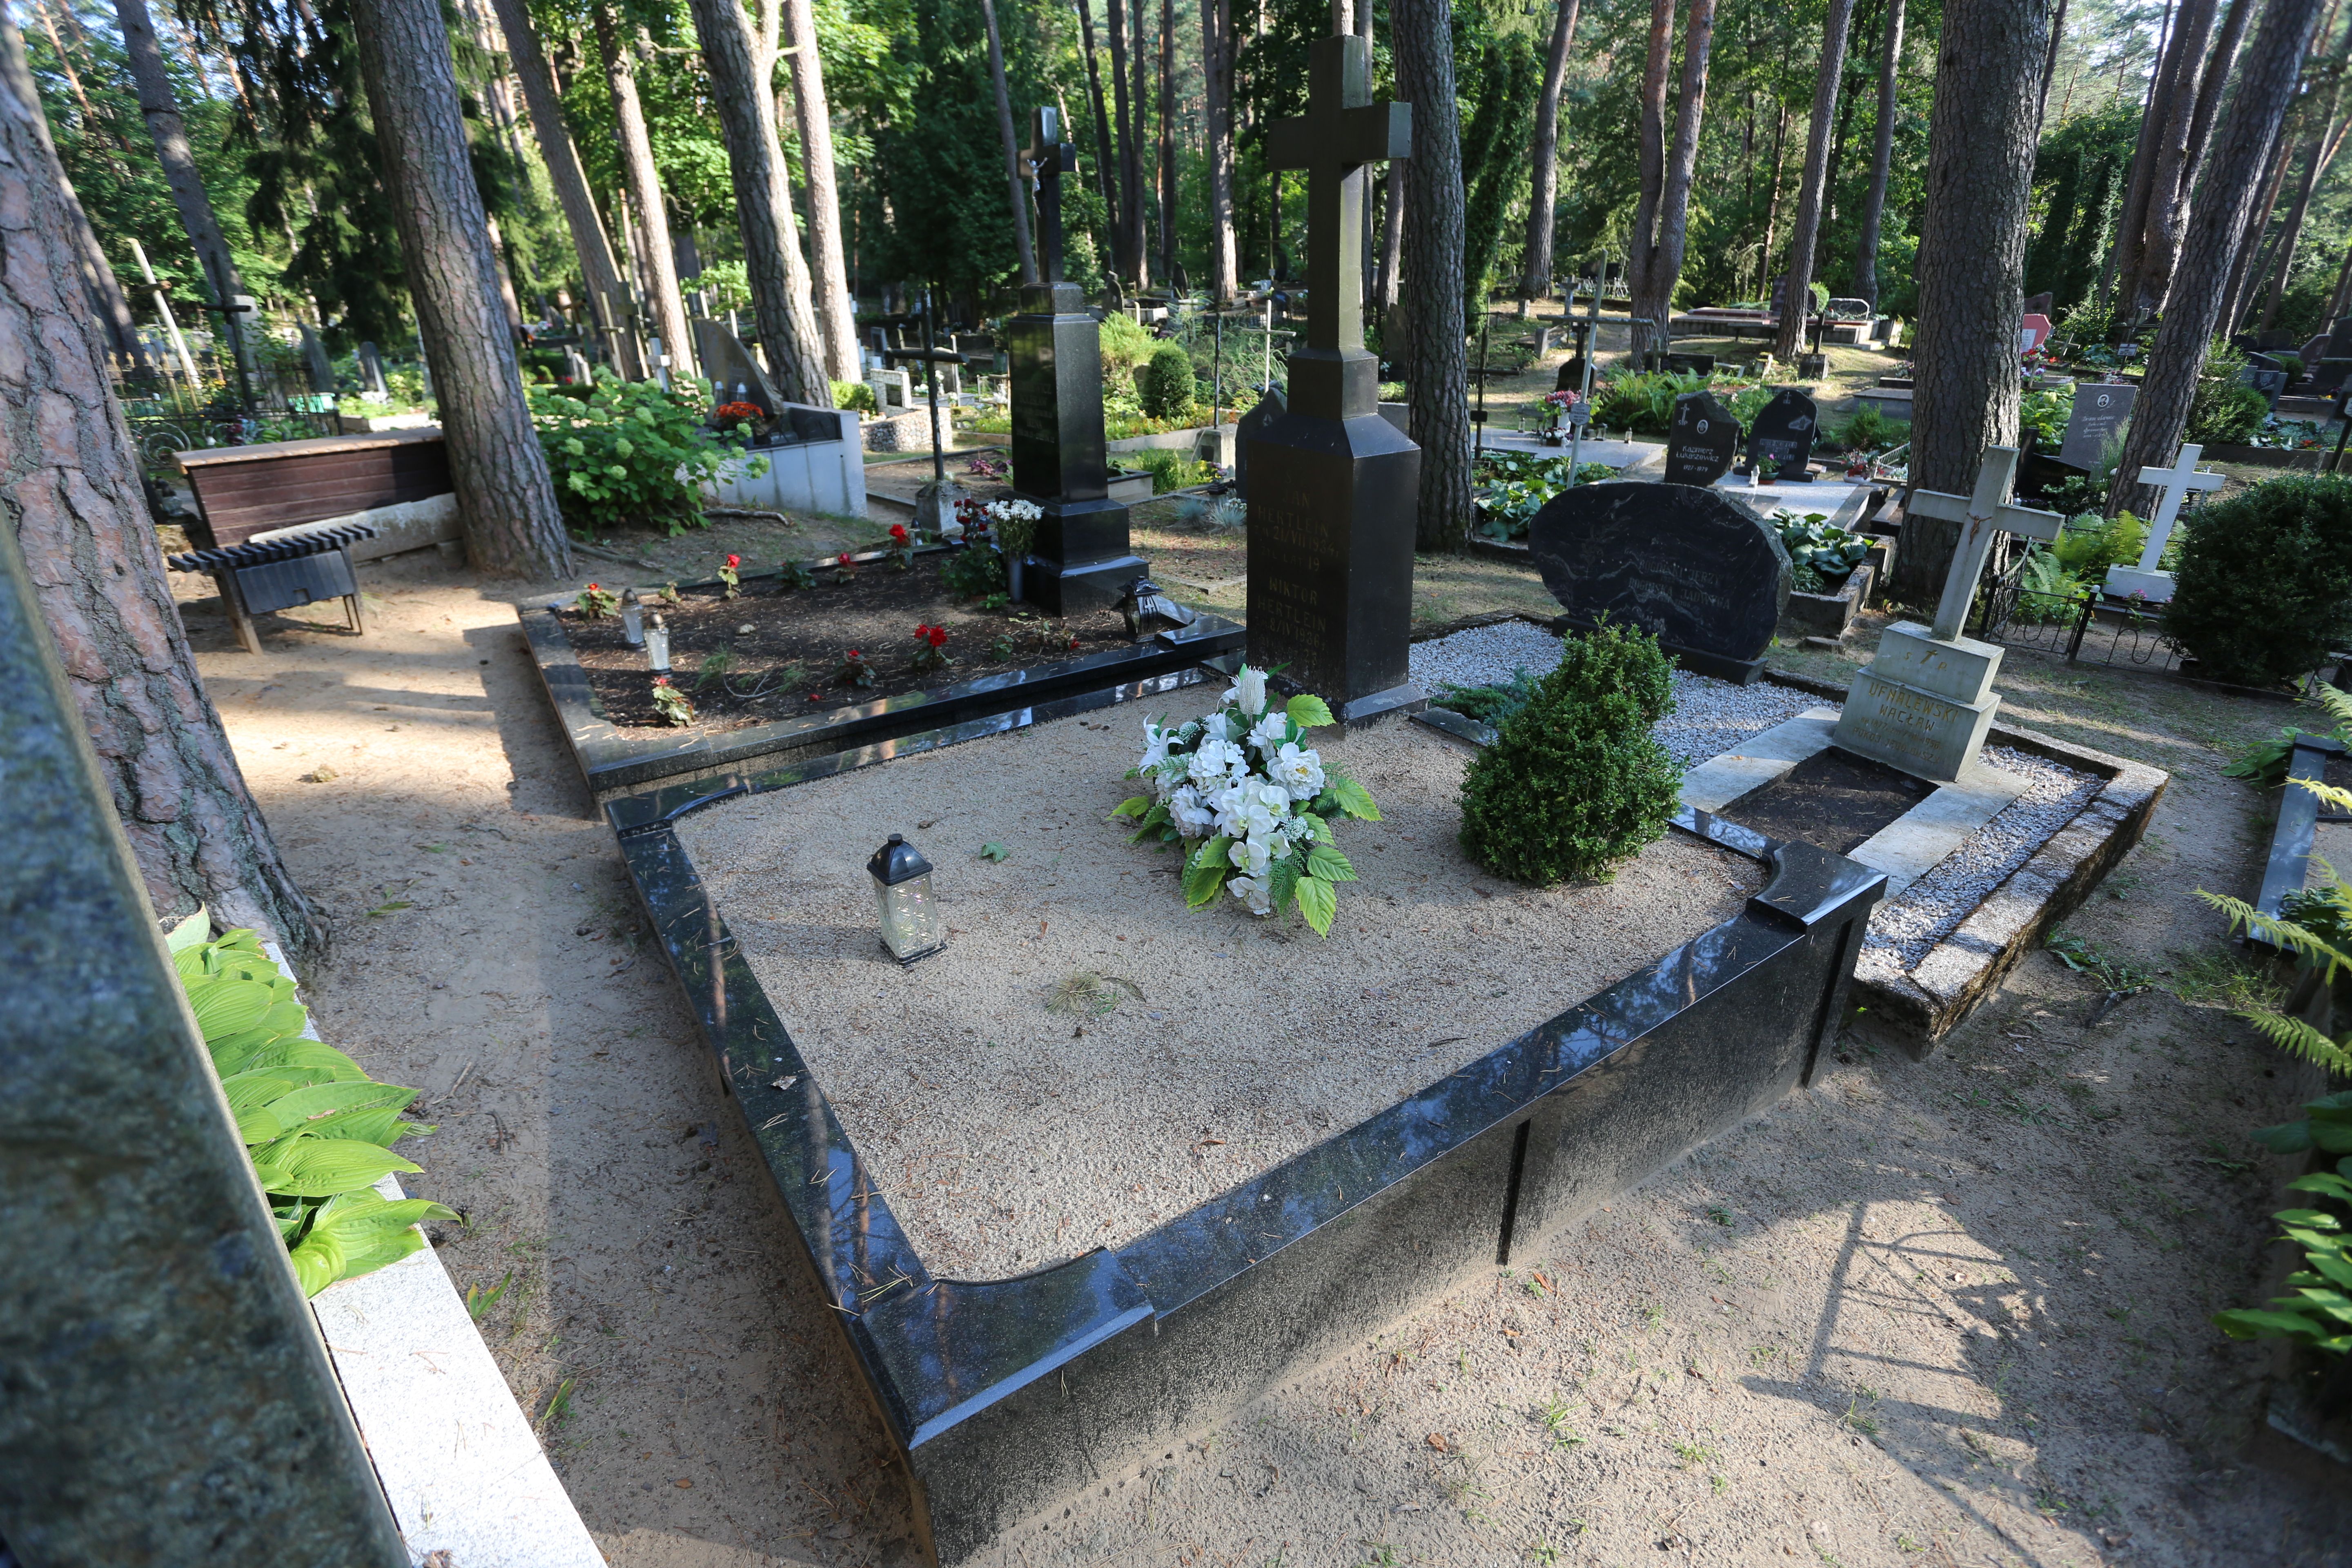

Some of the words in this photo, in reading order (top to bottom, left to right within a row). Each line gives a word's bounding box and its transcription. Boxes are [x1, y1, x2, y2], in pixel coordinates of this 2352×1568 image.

[1676, 451, 1719, 462] Łukaszewicz
[1682, 445, 1713, 455] Kazimierz
[1281, 487, 1311, 508] JAN
[1258, 504, 1330, 538] HERTLEIN
[1308, 555, 1320, 572] 19
[1688, 568, 1721, 586] JERZY
[1269, 576, 1318, 606] WIKTOR
[1257, 595, 1326, 633] HERTLEIN
[1869, 682, 1959, 724] UFNALEWSKI
[1879, 703, 1936, 732] WACŁAW
